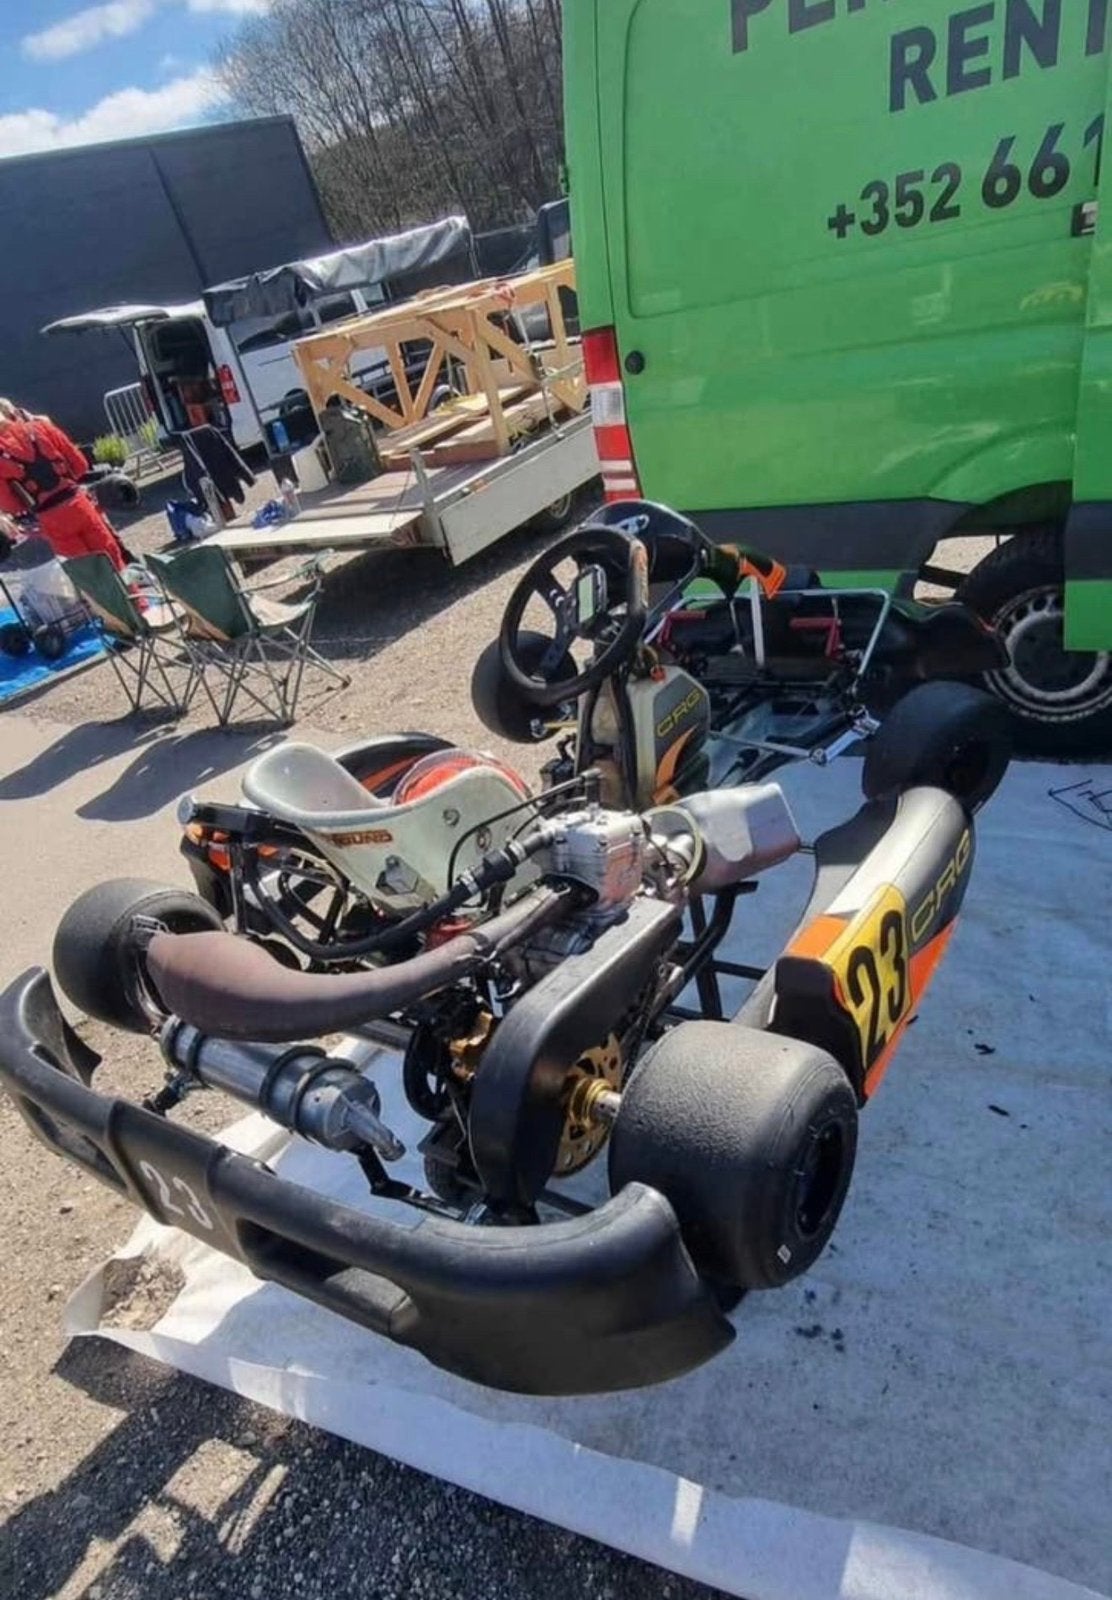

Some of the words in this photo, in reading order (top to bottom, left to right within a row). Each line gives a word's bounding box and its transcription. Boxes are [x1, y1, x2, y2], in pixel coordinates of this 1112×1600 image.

[828, 162, 961, 239] +352
[657, 688, 701, 737] CRG
[912, 828, 971, 943] CRG
[847, 909, 906, 1069] 23
[139, 1161, 213, 1230] 23
